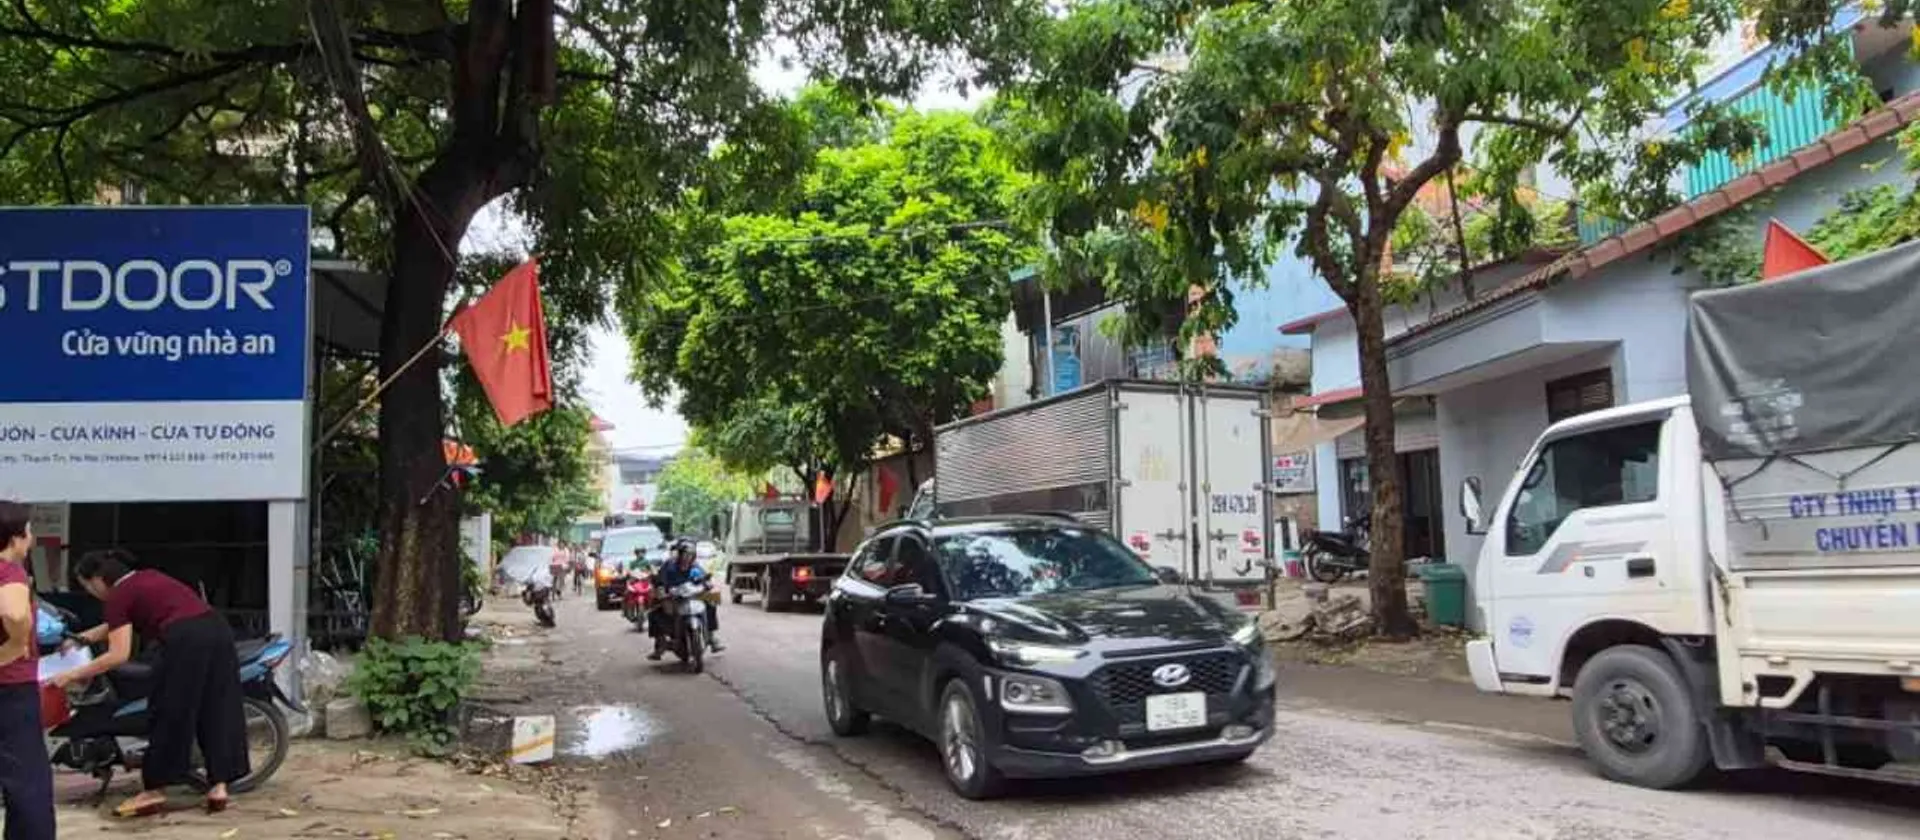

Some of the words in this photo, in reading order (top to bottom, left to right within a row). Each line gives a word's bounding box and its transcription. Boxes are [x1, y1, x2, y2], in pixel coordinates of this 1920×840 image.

[61, 327, 109, 356] Cửa
[114, 332, 182, 361] vững
[187, 327, 237, 355] nhà
[243, 334, 275, 355] an
